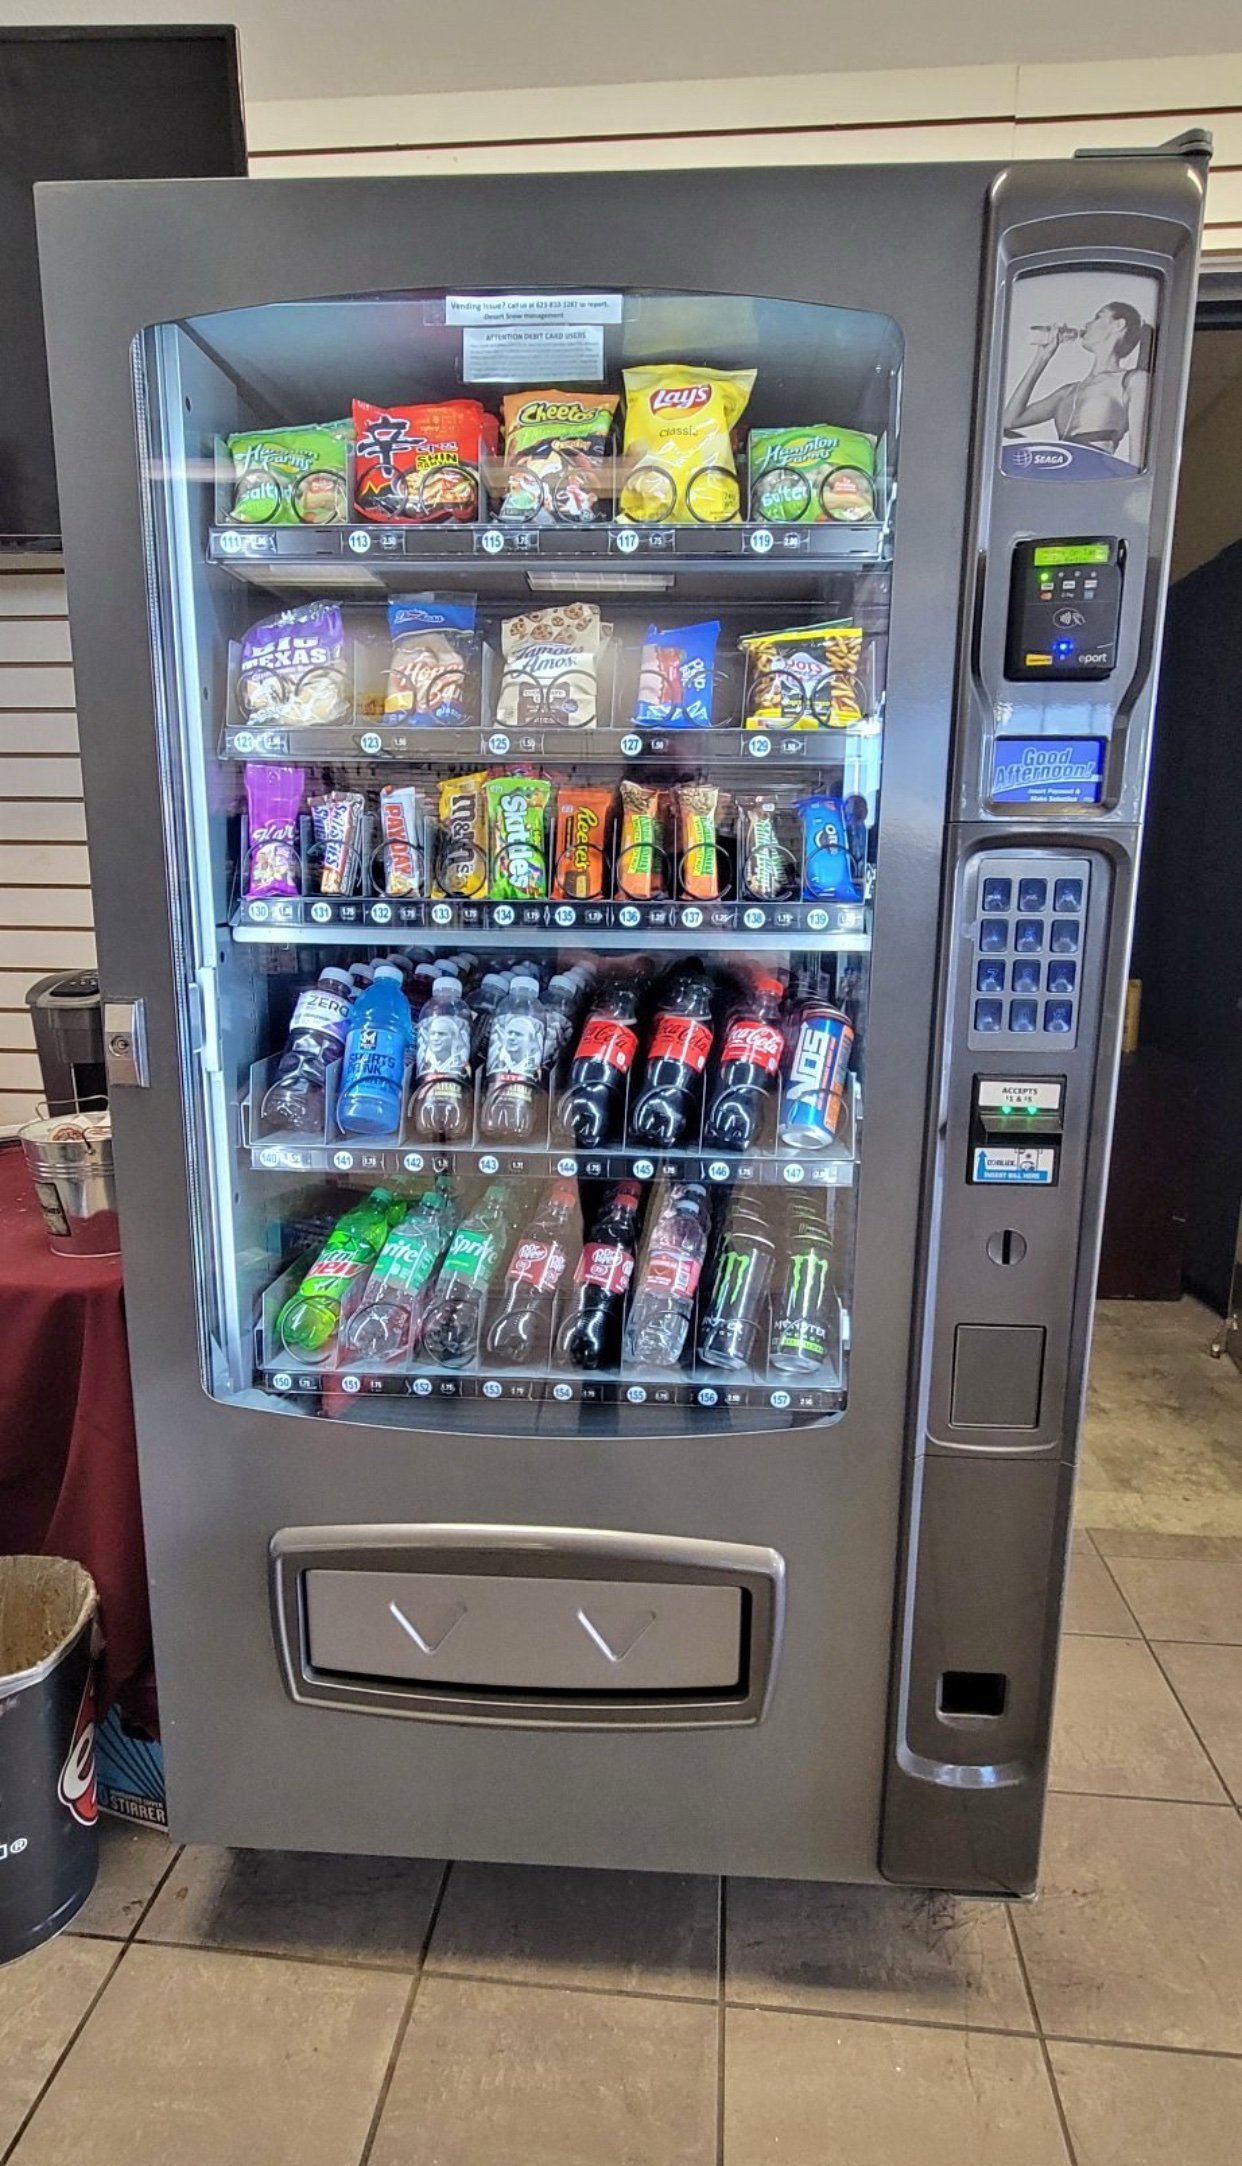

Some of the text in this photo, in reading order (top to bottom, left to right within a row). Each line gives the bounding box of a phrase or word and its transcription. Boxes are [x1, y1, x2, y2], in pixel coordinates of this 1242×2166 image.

[450, 301, 481, 311] Vending
[483, 301, 506, 310] Issue?
[524, 311, 564, 320] management
[486, 333, 524, 341] ATTENTION
[545, 332, 563, 340] CARD
[653, 384, 711, 409] Lay's
[521, 403, 596, 424] Cheetos
[417, 453, 457, 463] SHIN
[1034, 454, 1064, 464] SEAGA
[350, 536, 368, 548] 113
[484, 536, 502, 548] 115
[618, 536, 637, 546] 117
[754, 535, 770, 546] 119
[511, 645, 583, 661] Famous
[1078, 653, 1108, 664] eport
[242, 647, 327, 671] TEXAS
[514, 656, 577, 677] Amos
[237, 737, 252, 748] 121
[362, 736, 379, 748] 123
[492, 738, 508, 750] 125
[623, 738, 640, 750] 127
[752, 740, 768, 752] 129
[1023, 747, 1073, 767] Good
[994, 761, 1096, 786] Afternoon!
[383, 804, 415, 879] PAYDAY
[501, 795, 532, 888] Skittles
[250, 906, 266, 916] 130
[314, 906, 329, 917] 131
[373, 908, 388, 918] 132
[434, 908, 450, 918] 133
[496, 910, 512, 920] 134
[556, 910, 573, 921] 135
[621, 911, 638, 922] 136
[684, 912, 700, 922] 137
[746, 913, 762, 923] 138
[810, 914, 826, 924] 139
[307, 994, 350, 1018] ZERO
[786, 1022, 830, 1102] NOS
[336, 1156, 350, 1166] 141
[406, 1157, 421, 1168] 142
[481, 1160, 496, 1170] 143
[559, 1163, 575, 1174] 144
[635, 1164, 651, 1174] 145
[711, 1166, 727, 1176] 146
[786, 1168, 801, 1178] 147
[451, 1234, 498, 1262] Sprite
[274, 1377, 289, 1387] 150
[344, 1380, 358, 1390] 151
[415, 1382, 429, 1392] 152
[485, 1384, 500, 1394] 153
[556, 1388, 570, 1398] 154
[629, 1390, 644, 1400] 155
[700, 1392, 716, 1402] 156
[773, 1394, 788, 1404] 157
[110, 1796, 166, 1824] STIRRER
